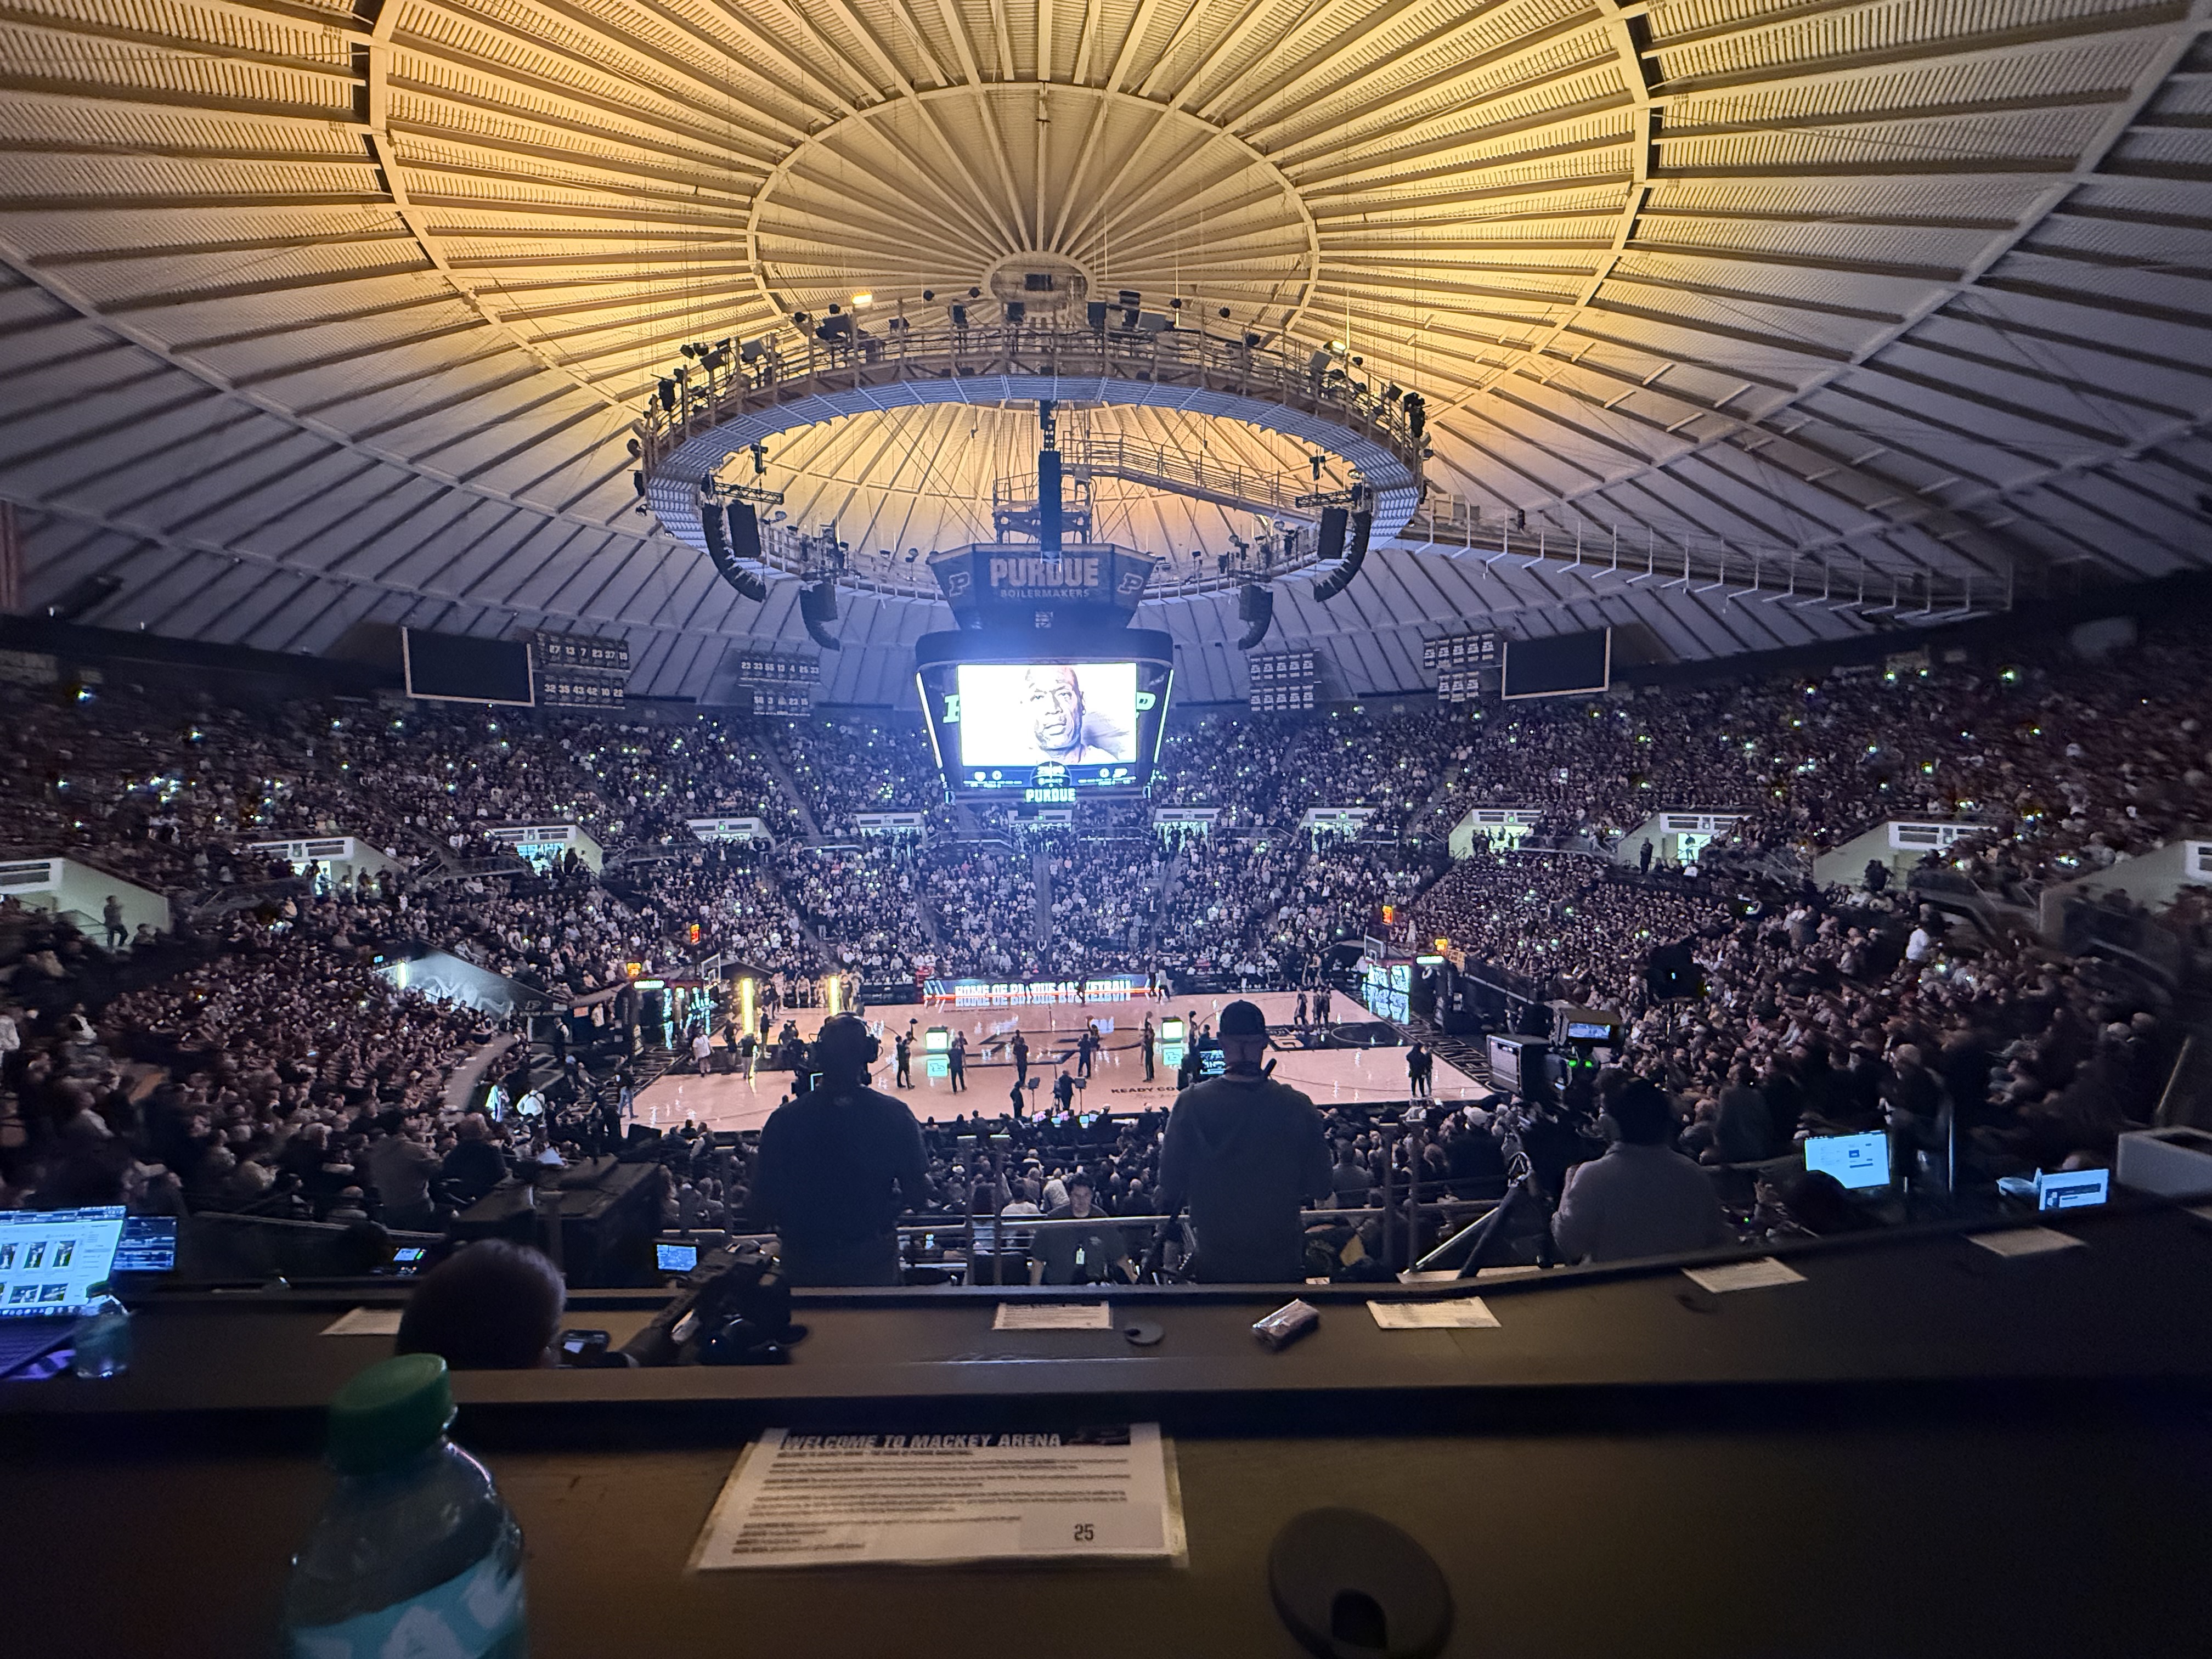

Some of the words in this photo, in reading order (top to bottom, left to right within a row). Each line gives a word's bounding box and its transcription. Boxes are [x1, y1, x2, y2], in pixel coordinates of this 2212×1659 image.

[990, 558, 1099, 586] PURDUE
[1000, 589, 1090, 599] BOILERMAKERS
[580, 648, 586, 656] 7
[573, 686, 584, 694] 43
[586, 687, 597, 696] 42
[601, 688, 610, 696] 10
[1025, 788, 1077, 803] PURDUE
[955, 985, 990, 996] HOME
[992, 983, 1008, 995] OF
[780, 1435, 878, 1450] WELCOME
[884, 1434, 906, 1448] TO
[909, 1434, 991, 1448] MACKEY
[998, 1433, 1061, 1447] ARENA
[1074, 1523, 1094, 1541] 25
